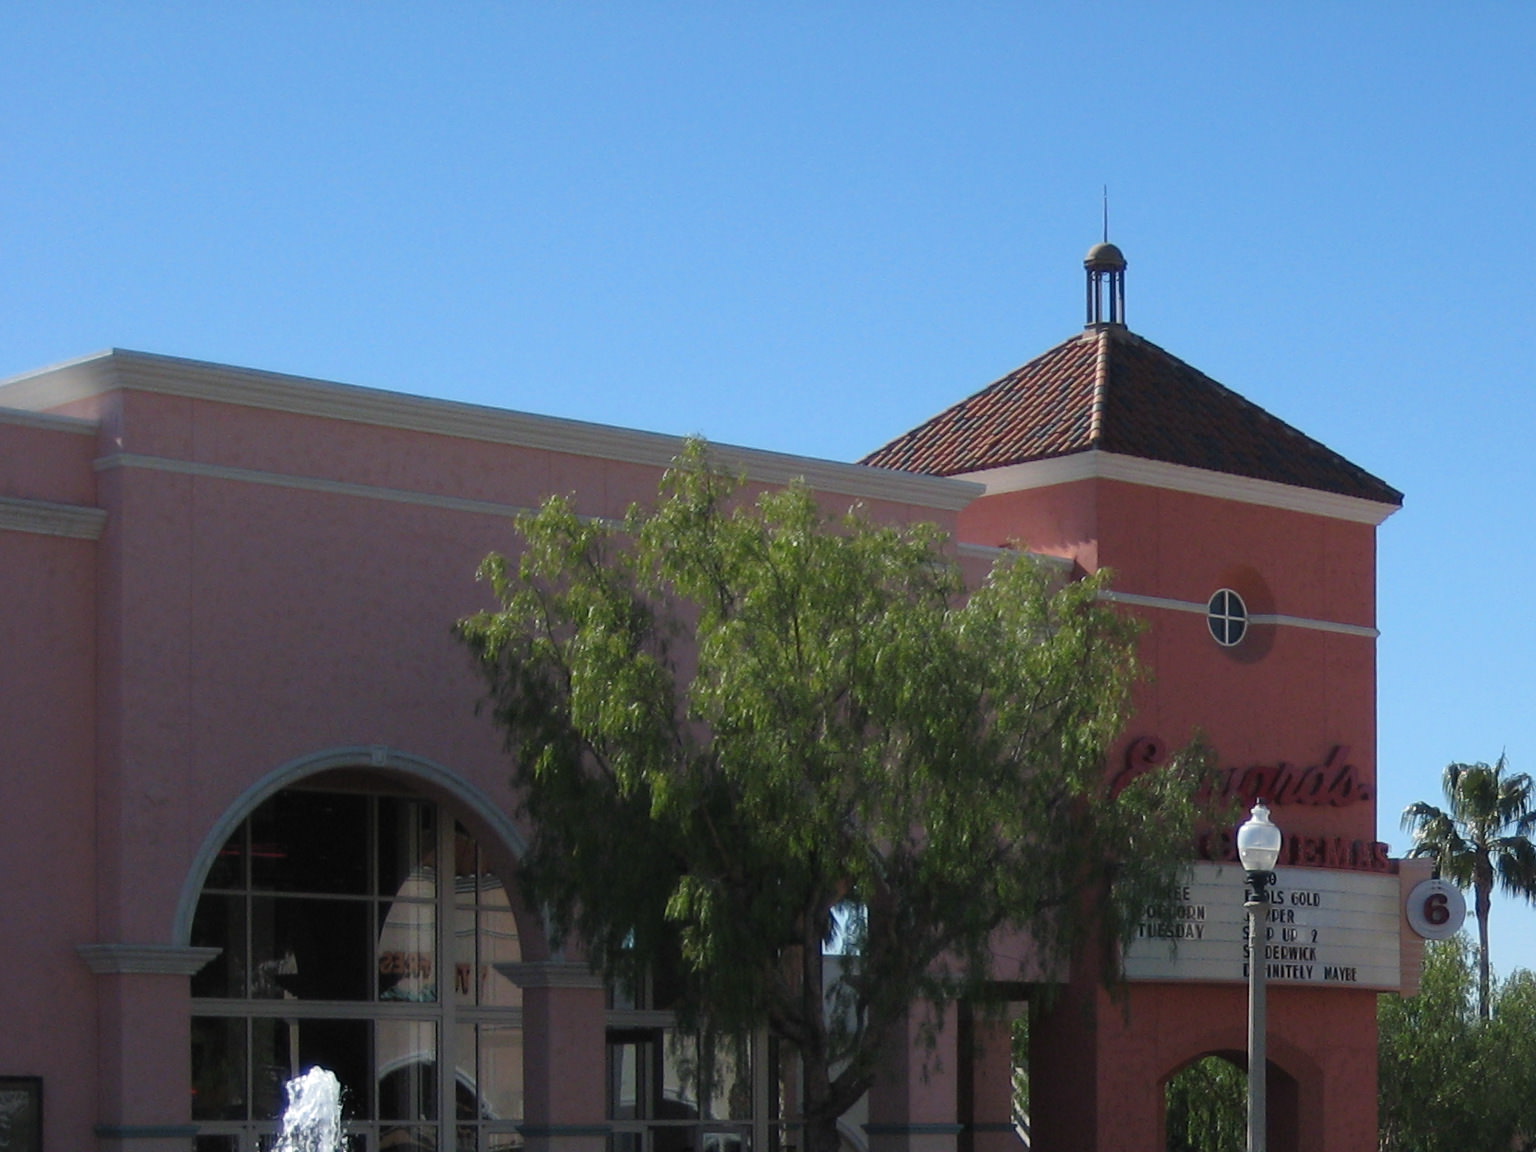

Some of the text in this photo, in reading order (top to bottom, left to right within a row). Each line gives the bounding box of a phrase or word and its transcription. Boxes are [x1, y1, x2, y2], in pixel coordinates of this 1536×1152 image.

[1244, 889, 1320, 907] FLS GOLD
[1244, 909, 1295, 924] JPER
[1423, 893, 1450, 925] 6
[1138, 922, 1205, 939] TUESDAY
[1243, 944, 1318, 961] SDERWICK
[1243, 963, 1358, 982] DINITELY MAYBE
